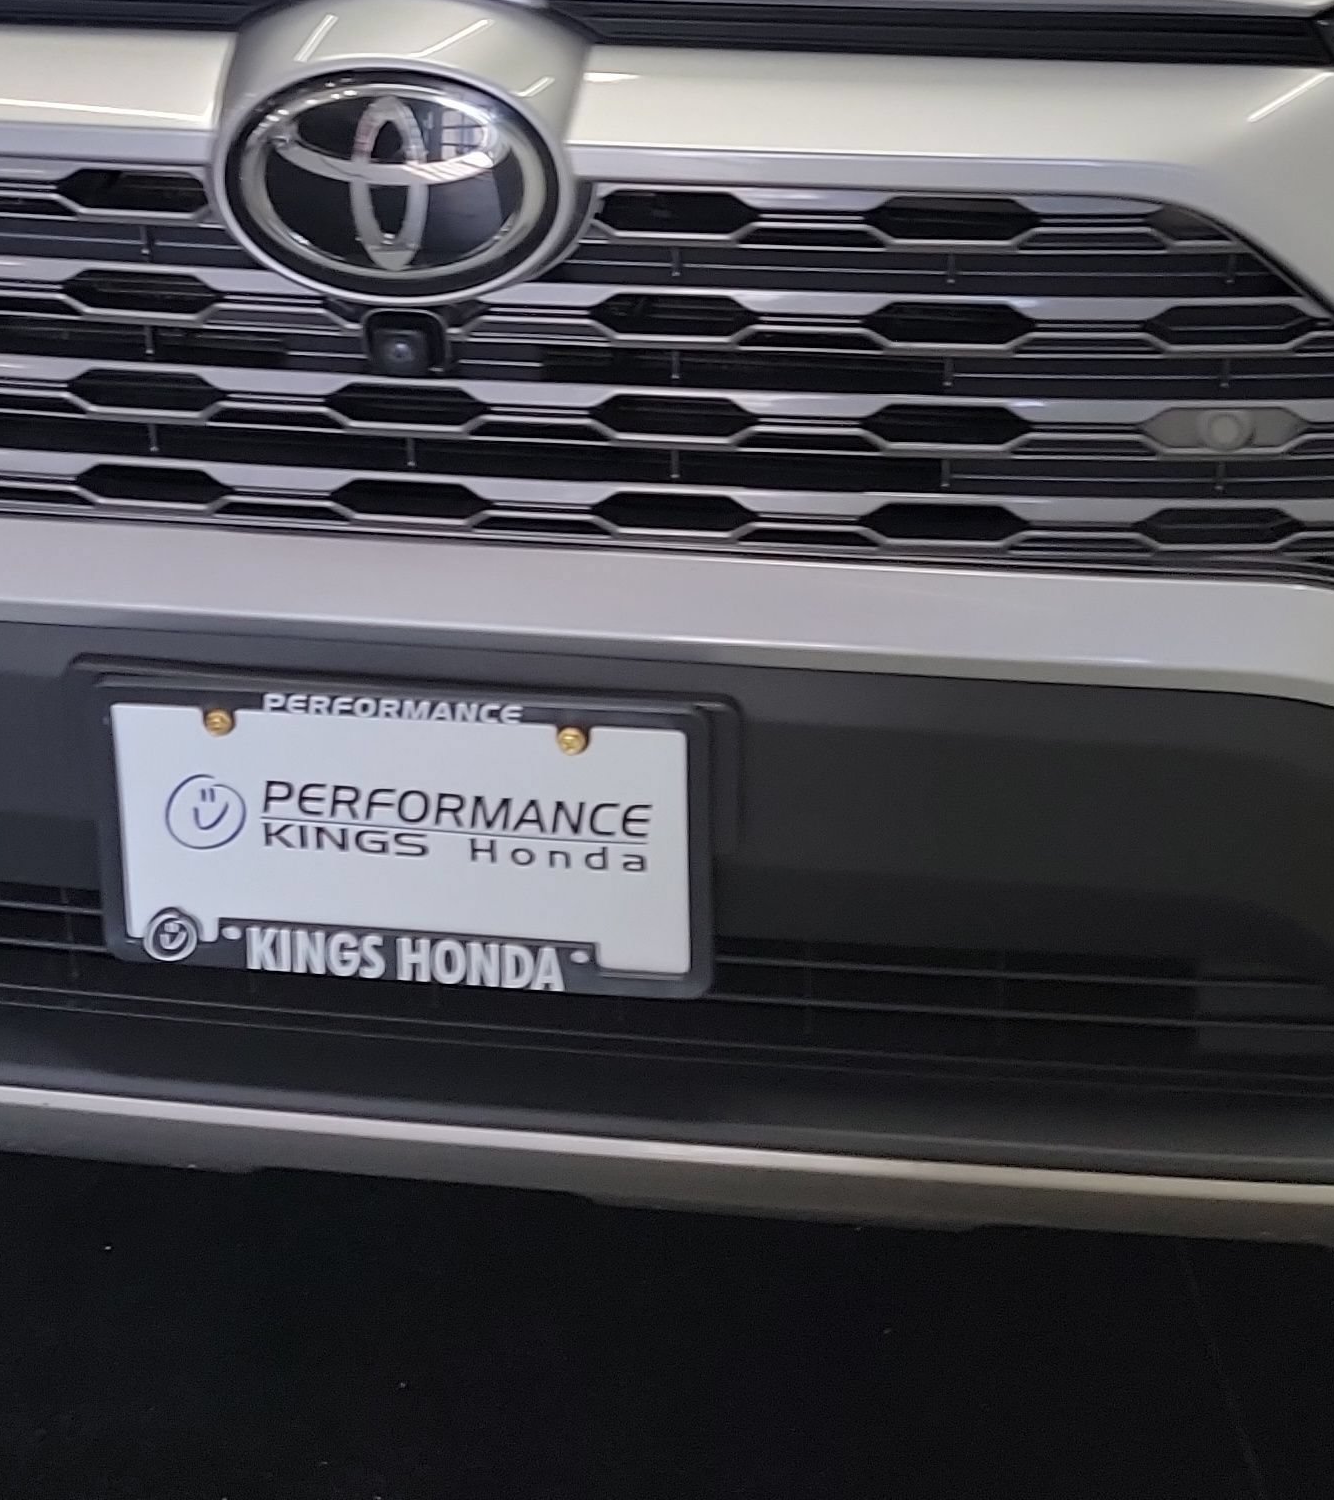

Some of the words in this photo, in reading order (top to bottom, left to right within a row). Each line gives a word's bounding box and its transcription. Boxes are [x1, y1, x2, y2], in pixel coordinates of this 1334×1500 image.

[262, 693, 524, 724] PERFORMANCE
[263, 780, 653, 837] PERFORMANCE
[263, 822, 429, 857] KINGS
[469, 837, 648, 873] Honda
[245, 926, 386, 980] KINGS
[396, 937, 565, 992] HONDA
